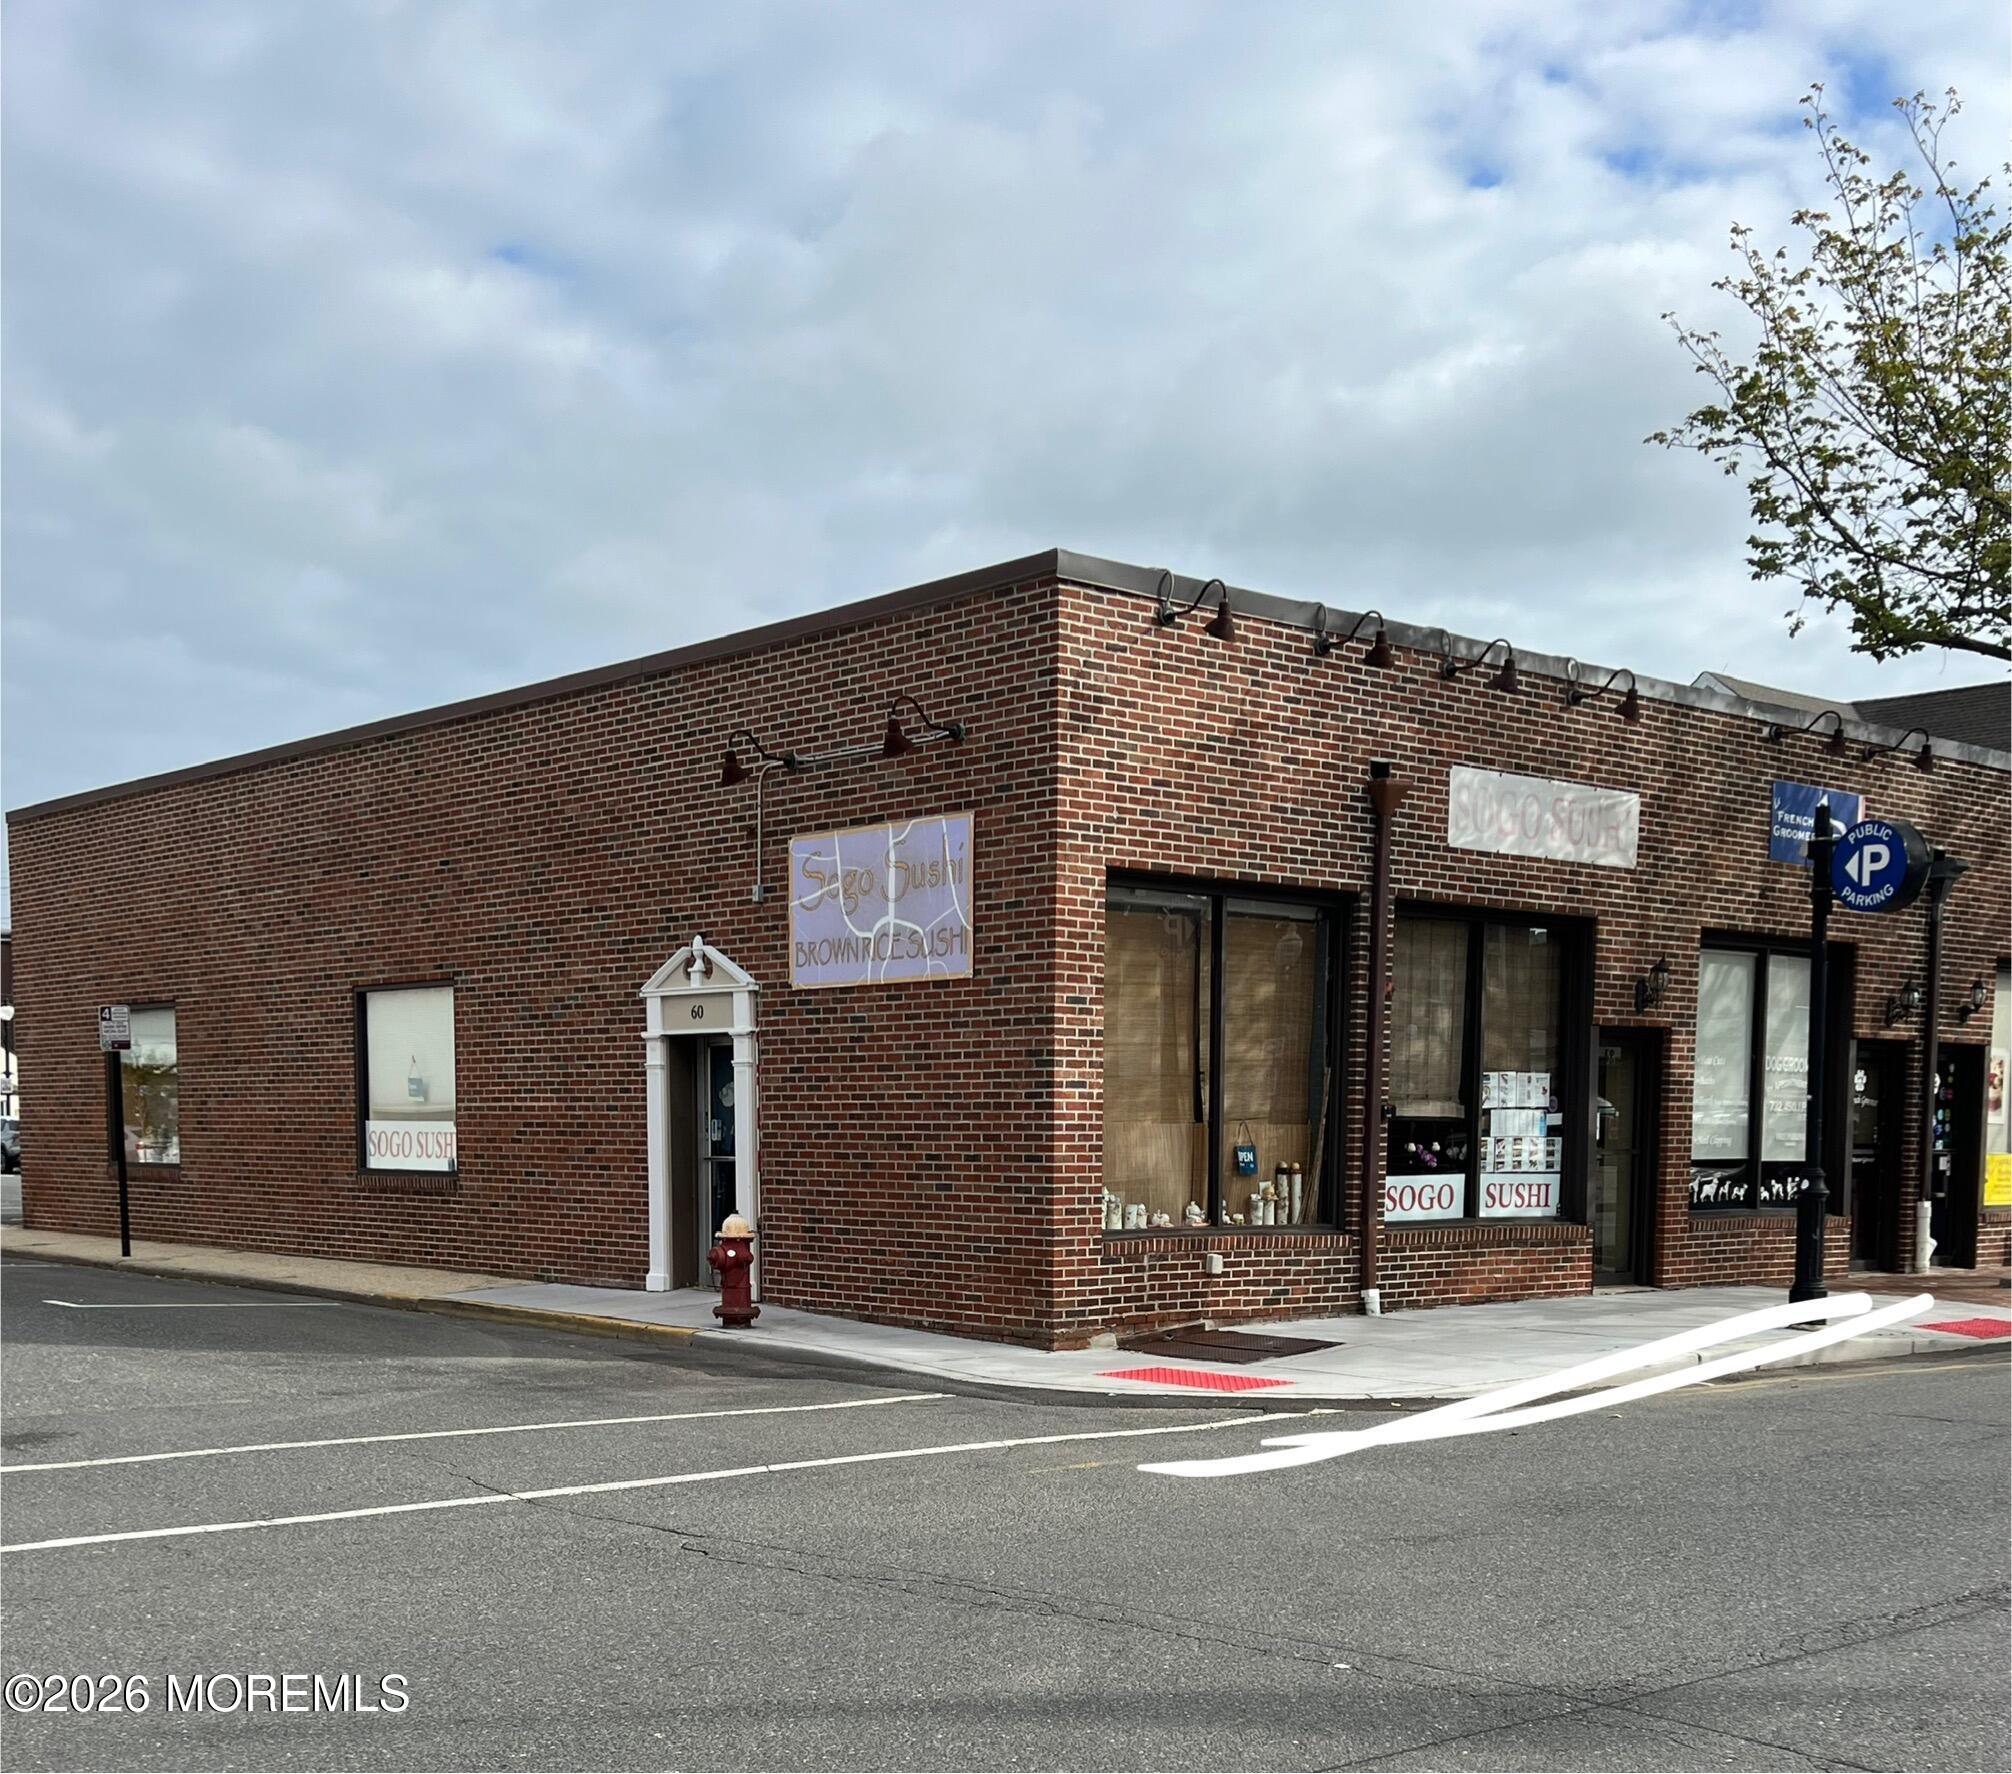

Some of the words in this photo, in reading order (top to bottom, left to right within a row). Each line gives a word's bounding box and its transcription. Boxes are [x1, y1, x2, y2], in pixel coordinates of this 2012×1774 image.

[1455, 783, 1541, 840] SOGO
[1777, 810, 1815, 827] FRENCH
[1848, 823, 1893, 845] PUBLIC
[798, 850, 875, 916] Sogo
[879, 832, 964, 903] Sushi
[1861, 844, 1891, 887] P
[1841, 883, 1895, 907] PARKING
[794, 936, 859, 968] BROWN
[861, 931, 906, 962] RICE
[906, 925, 968, 960] SUSHI
[102, 1008, 110, 1020] 4
[690, 1004, 704, 1020] 60
[368, 1130, 413, 1158] SOGO
[416, 1130, 456, 1159] SUSH
[1385, 1183, 1455, 1212] SOGO
[1485, 1182, 1552, 1209] SUSHI
